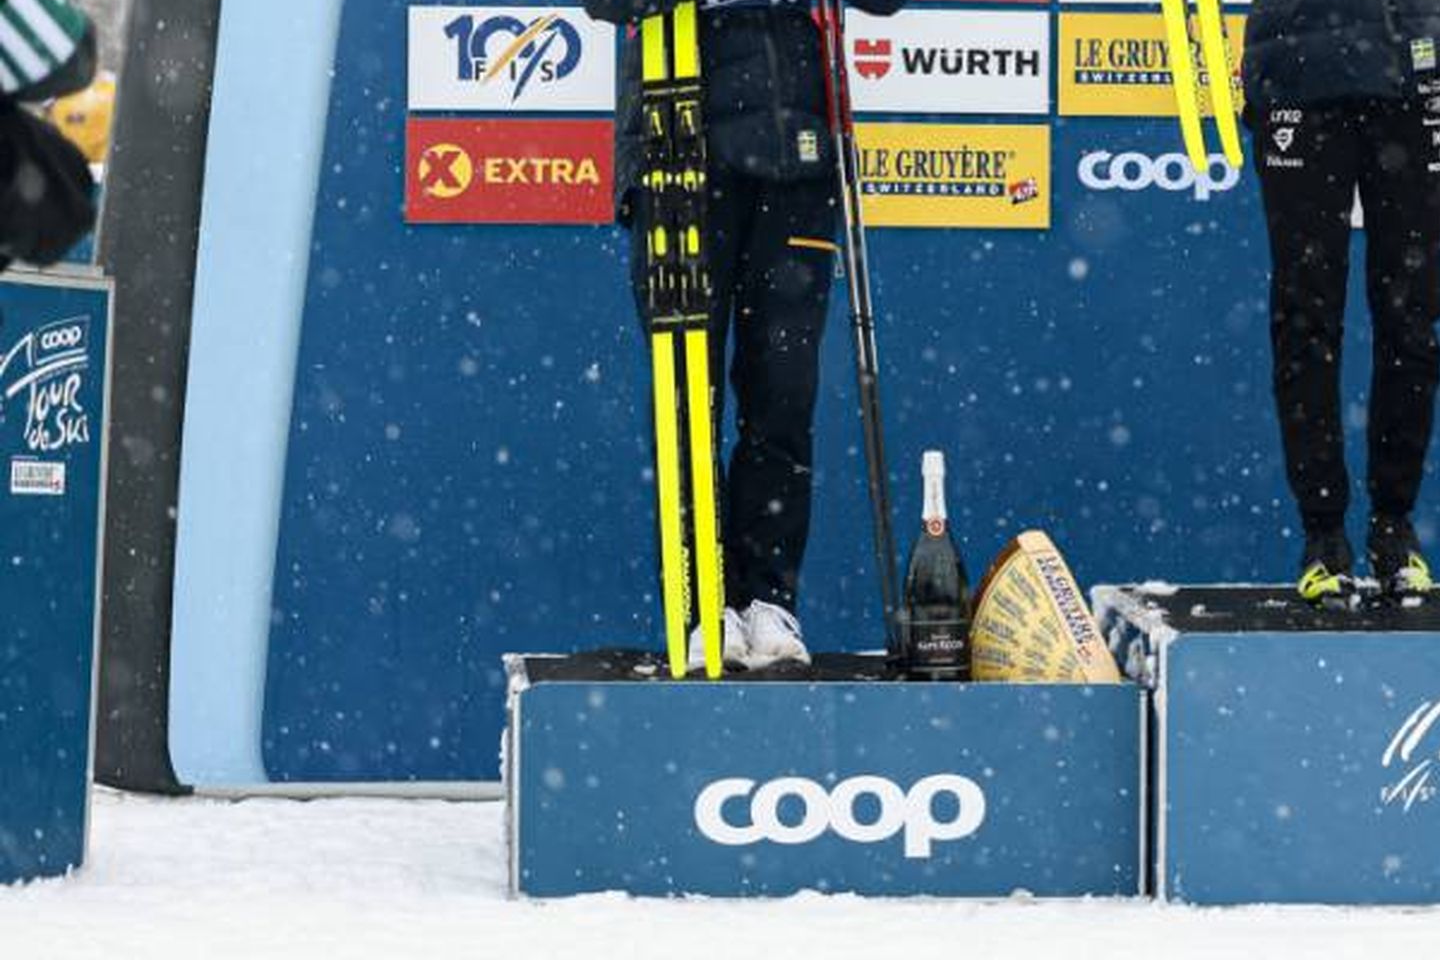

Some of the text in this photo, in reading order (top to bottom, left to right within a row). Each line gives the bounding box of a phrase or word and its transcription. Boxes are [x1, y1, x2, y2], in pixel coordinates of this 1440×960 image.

[902, 47, 1040, 77] WÜRTH
[1075, 38, 1102, 68] LE
[484, 158, 600, 185] EXTRA
[862, 144, 1007, 179] LE GRUYÈRE
[1077, 152, 1240, 201] coop
[41, 325, 82, 349] coop
[695, 775, 987, 859] coop
